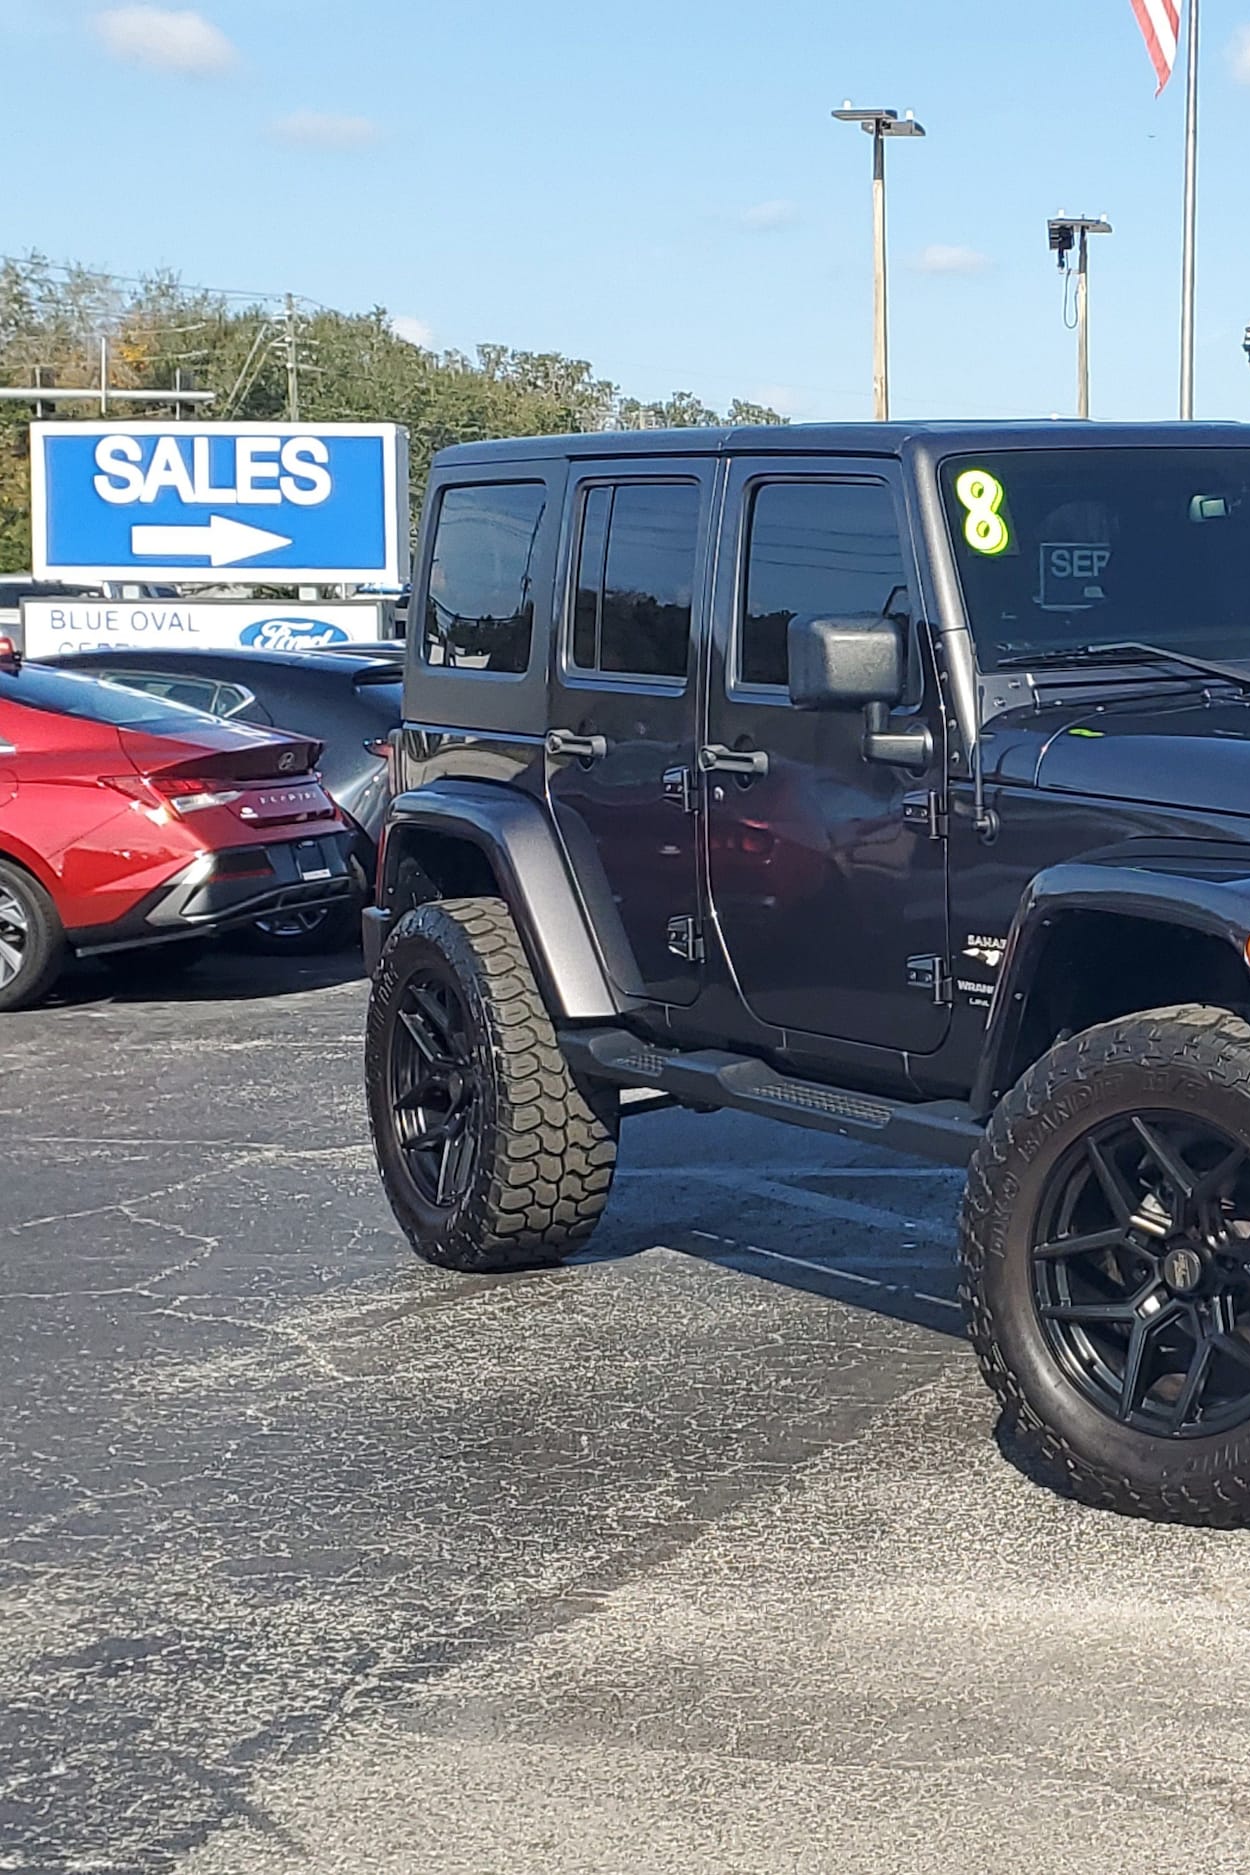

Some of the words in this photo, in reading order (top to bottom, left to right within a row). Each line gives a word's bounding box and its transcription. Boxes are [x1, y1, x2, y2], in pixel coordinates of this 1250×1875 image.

[94, 434, 332, 506] SALES
[956, 470, 1009, 554] 8
[50, 609, 119, 631] BLUE
[131, 610, 200, 632] OVAL
[252, 620, 334, 650] Ford
